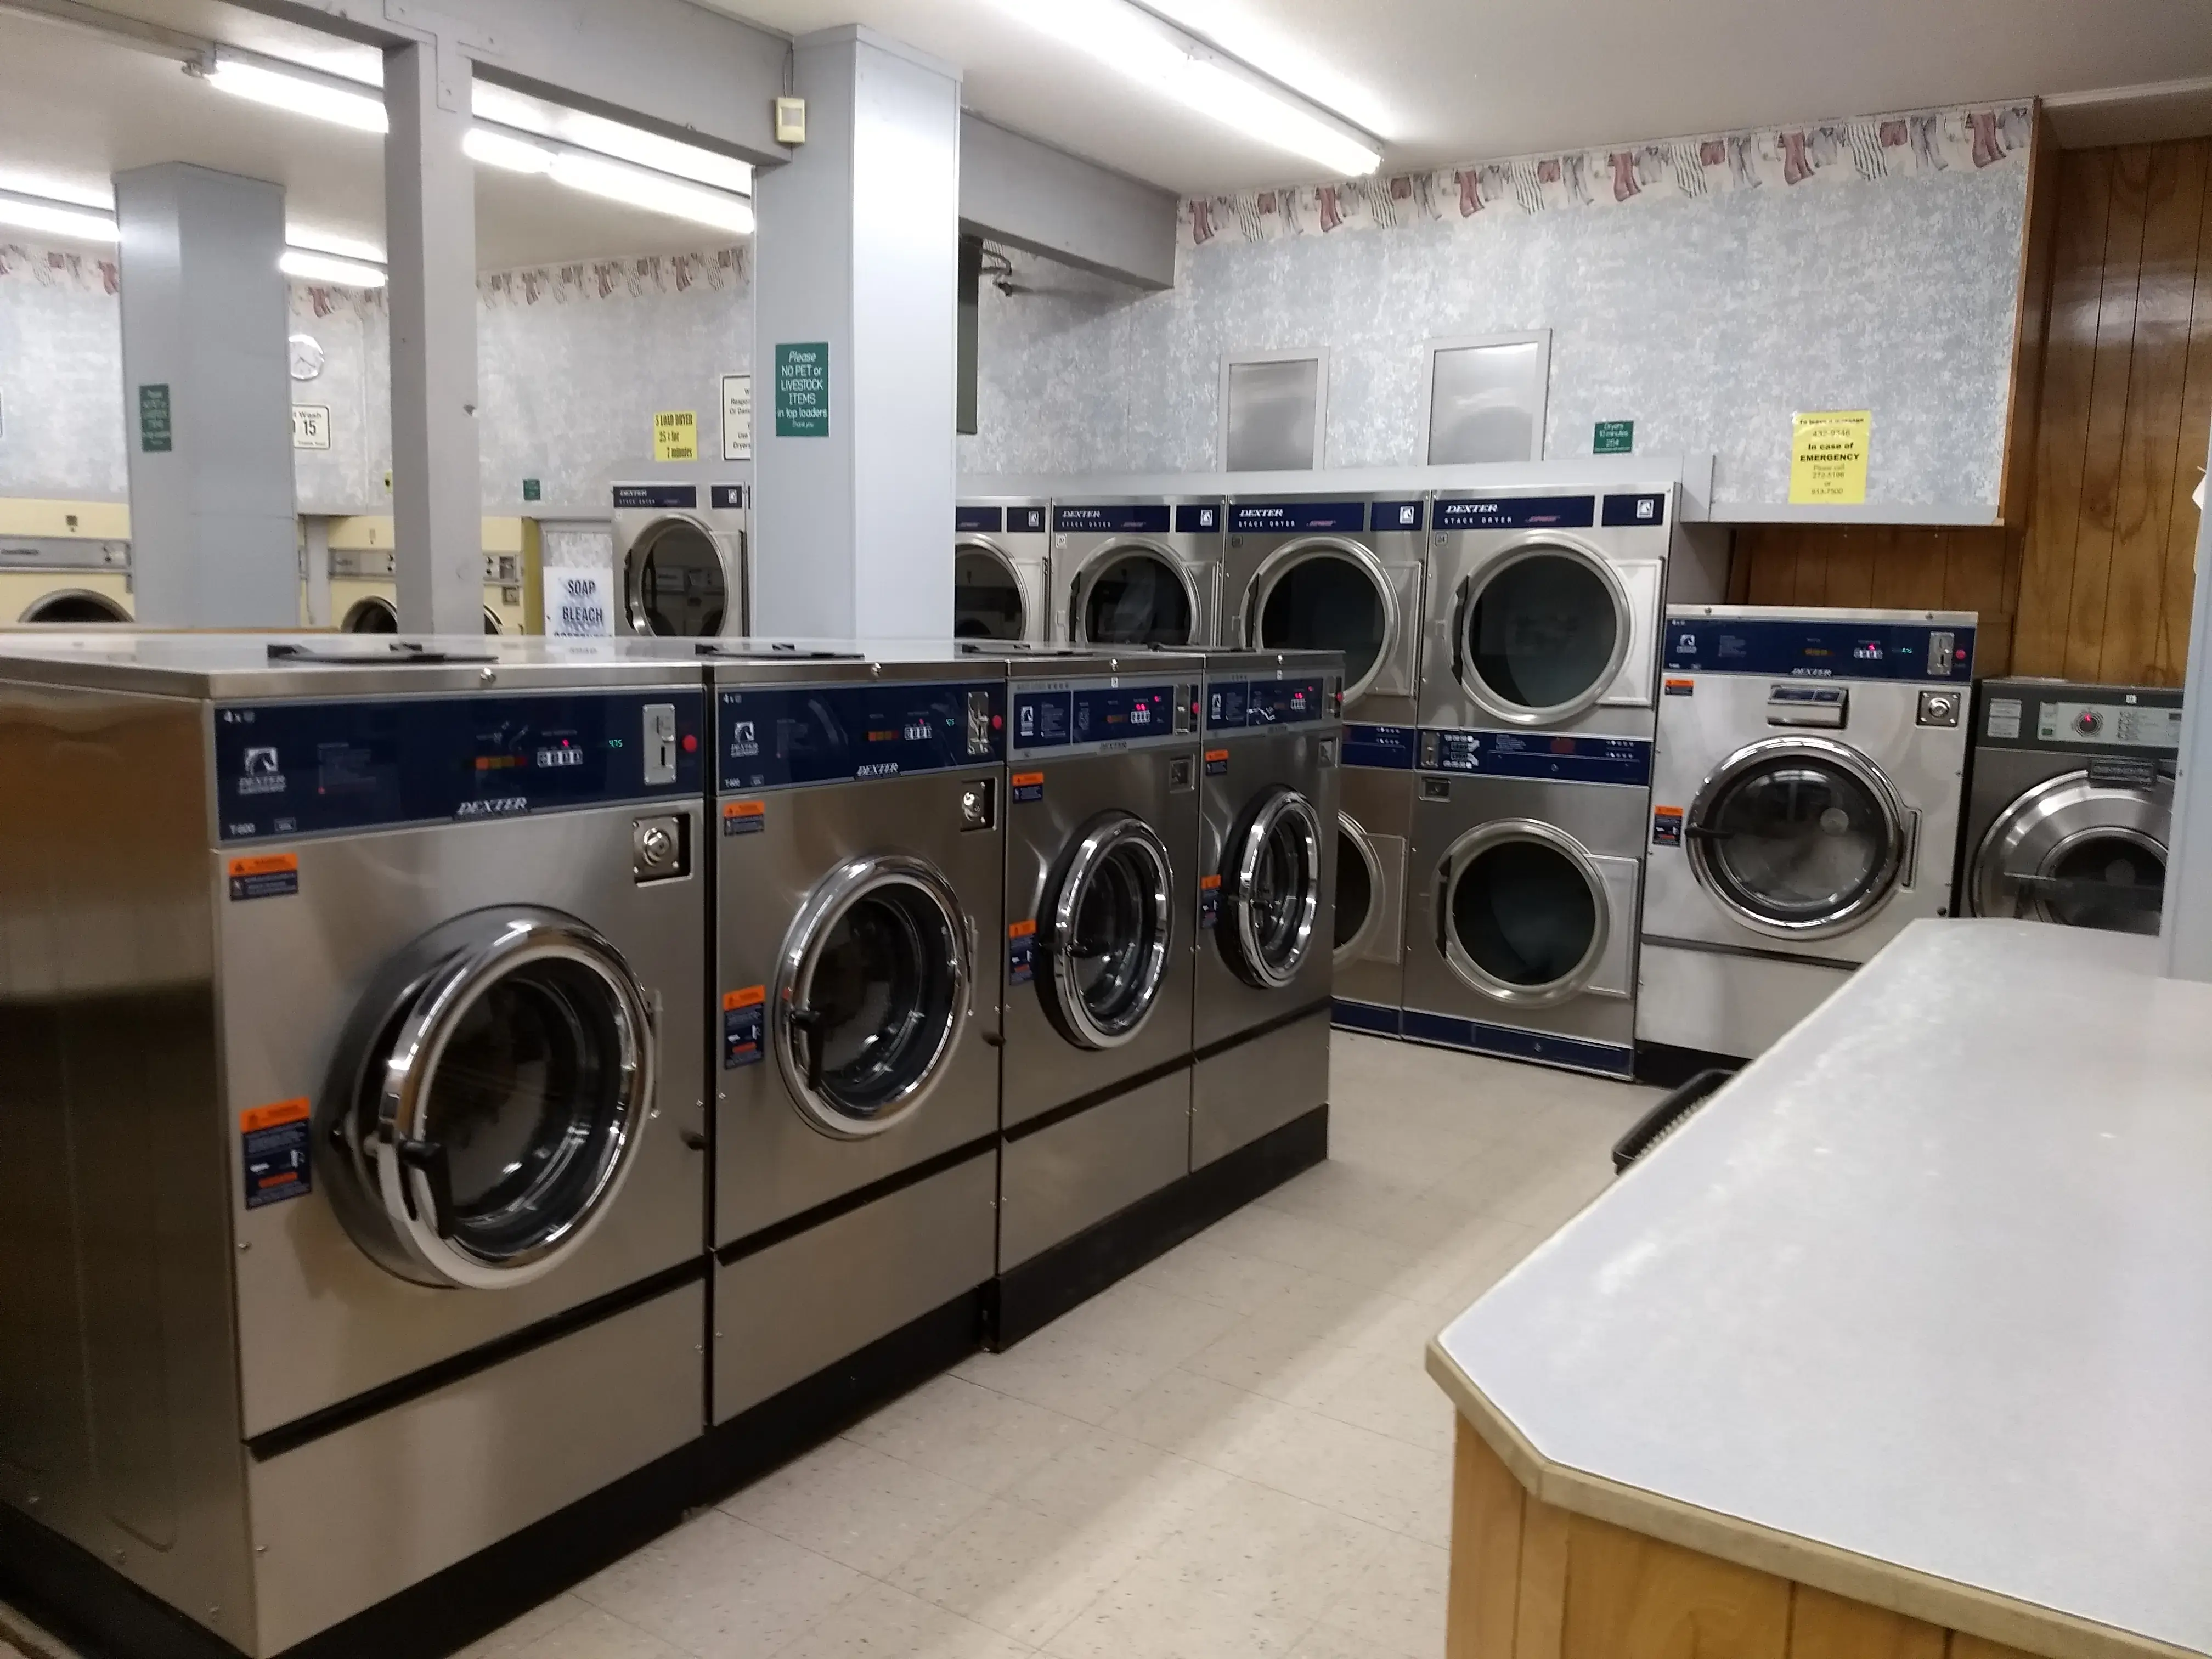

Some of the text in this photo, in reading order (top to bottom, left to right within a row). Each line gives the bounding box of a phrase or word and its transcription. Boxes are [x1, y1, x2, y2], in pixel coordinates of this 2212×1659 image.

[789, 351, 816, 363] Please
[781, 364, 823, 377] NO PET or
[781, 379, 823, 391] LIVESTOCK
[789, 393, 816, 405] ITEMS
[661, 414, 674, 426] LOAD
[675, 413, 692, 426] DRYER
[777, 407, 827, 421] in top loaders
[303, 419, 317, 436] 15
[1800, 453, 1860, 462] EMERGENCY
[1062, 510, 1101, 518] DEXTER
[1238, 508, 1284, 518] DEXTER
[1444, 504, 1499, 514] DEXTER
[1238, 520, 1263, 528] STACK
[1444, 516, 1513, 525] STACK DRYER
[567, 579, 596, 595] SOAP
[562, 606, 603, 622] BLEACH
[856, 762, 899, 777] DEXTER
[456, 797, 528, 816] DEXTER
